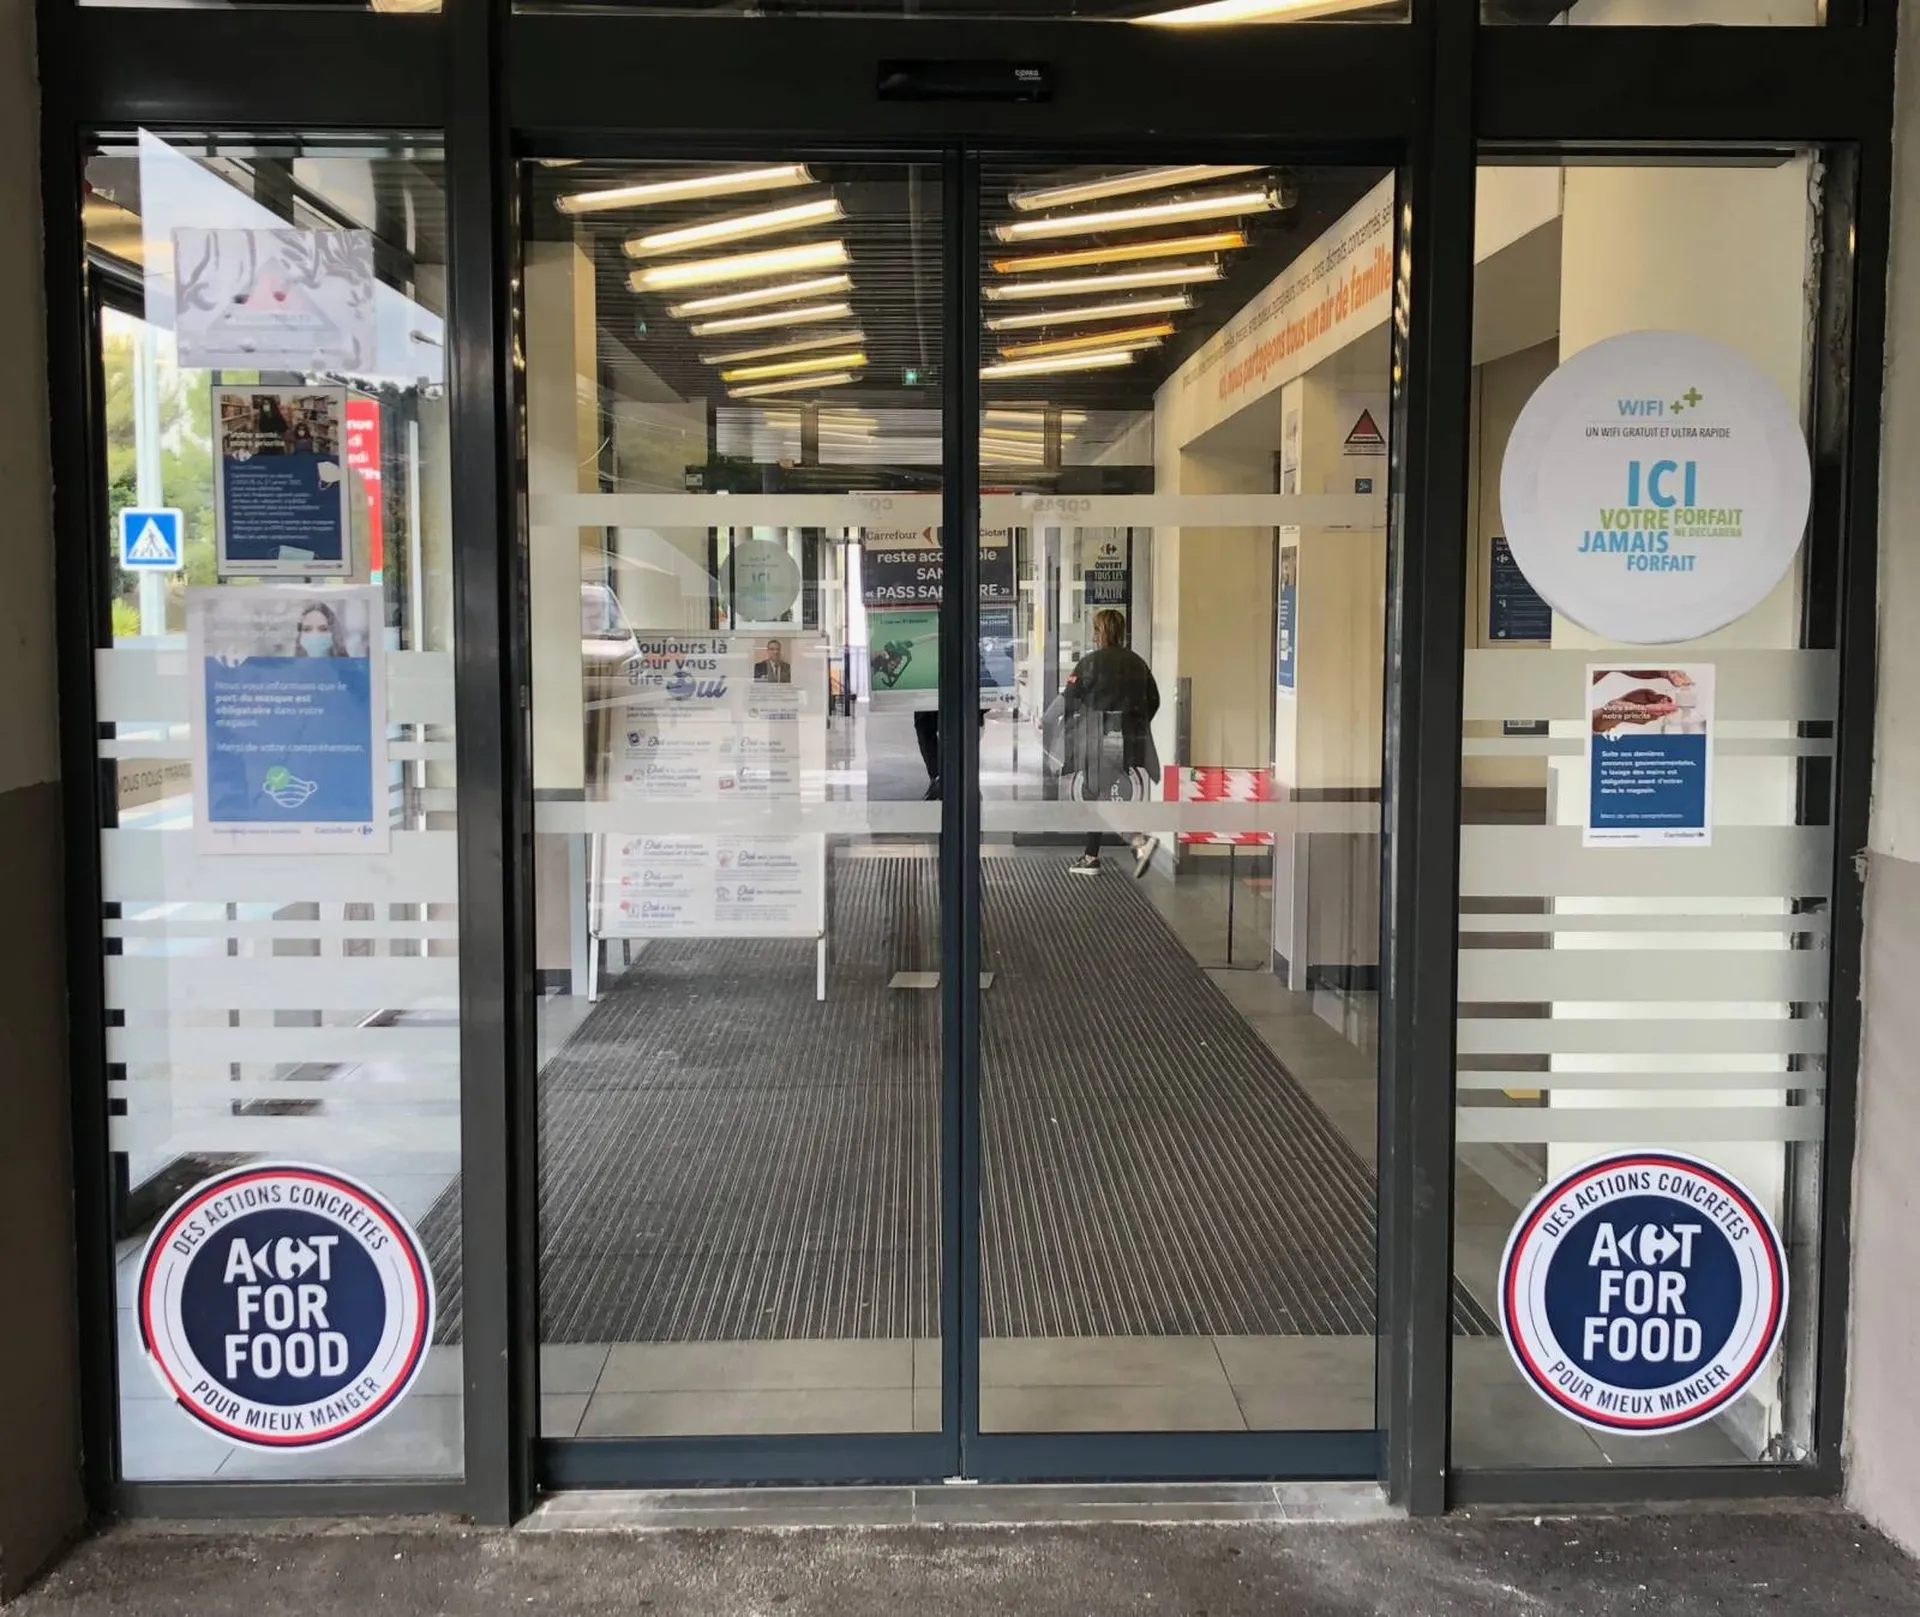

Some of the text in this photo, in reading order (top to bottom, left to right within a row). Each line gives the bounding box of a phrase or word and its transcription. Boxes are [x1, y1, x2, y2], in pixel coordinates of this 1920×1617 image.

[1242, 343, 1285, 393] partageons
[1286, 319, 1305, 356] tous
[1307, 313, 1318, 342] un
[1320, 284, 1334, 334] air
[1334, 278, 1348, 323] de
[1350, 243, 1391, 313] famille
[1617, 399, 1663, 417] WIFI
[1585, 427, 1730, 439] UN WIFI GRATUIT ET ULTRA RAPIDE
[1628, 460, 1697, 508] ICI
[1599, 508, 1743, 530] VOTRE FORFAIT
[866, 530, 917, 541] Carrefour
[1577, 530, 1669, 553] JAMAIS
[877, 550, 917, 563] reste
[1095, 561, 1122, 569] OUVERT
[1627, 554, 1697, 572] FORFAIT
[877, 586, 915, 599] PASS
[712, 640, 728, 655] là
[677, 659, 717, 671] vous
[215, 706, 271, 717] obligatoire
[1542, 1172, 1750, 1241] DES ACTIONS CONCRÈTES
[173, 1185, 389, 1256] DES ACTIONS CONCRÈTES
[1599, 1269, 1687, 1315] FOR
[237, 1283, 330, 1331] FOR
[1583, 1317, 1702, 1363] FOOD
[225, 1331, 349, 1379] FOOD
[1548, 1360, 1731, 1414] POUR MIEUX MANGER
[192, 1376, 382, 1431] POUR MIEUX MANGER
